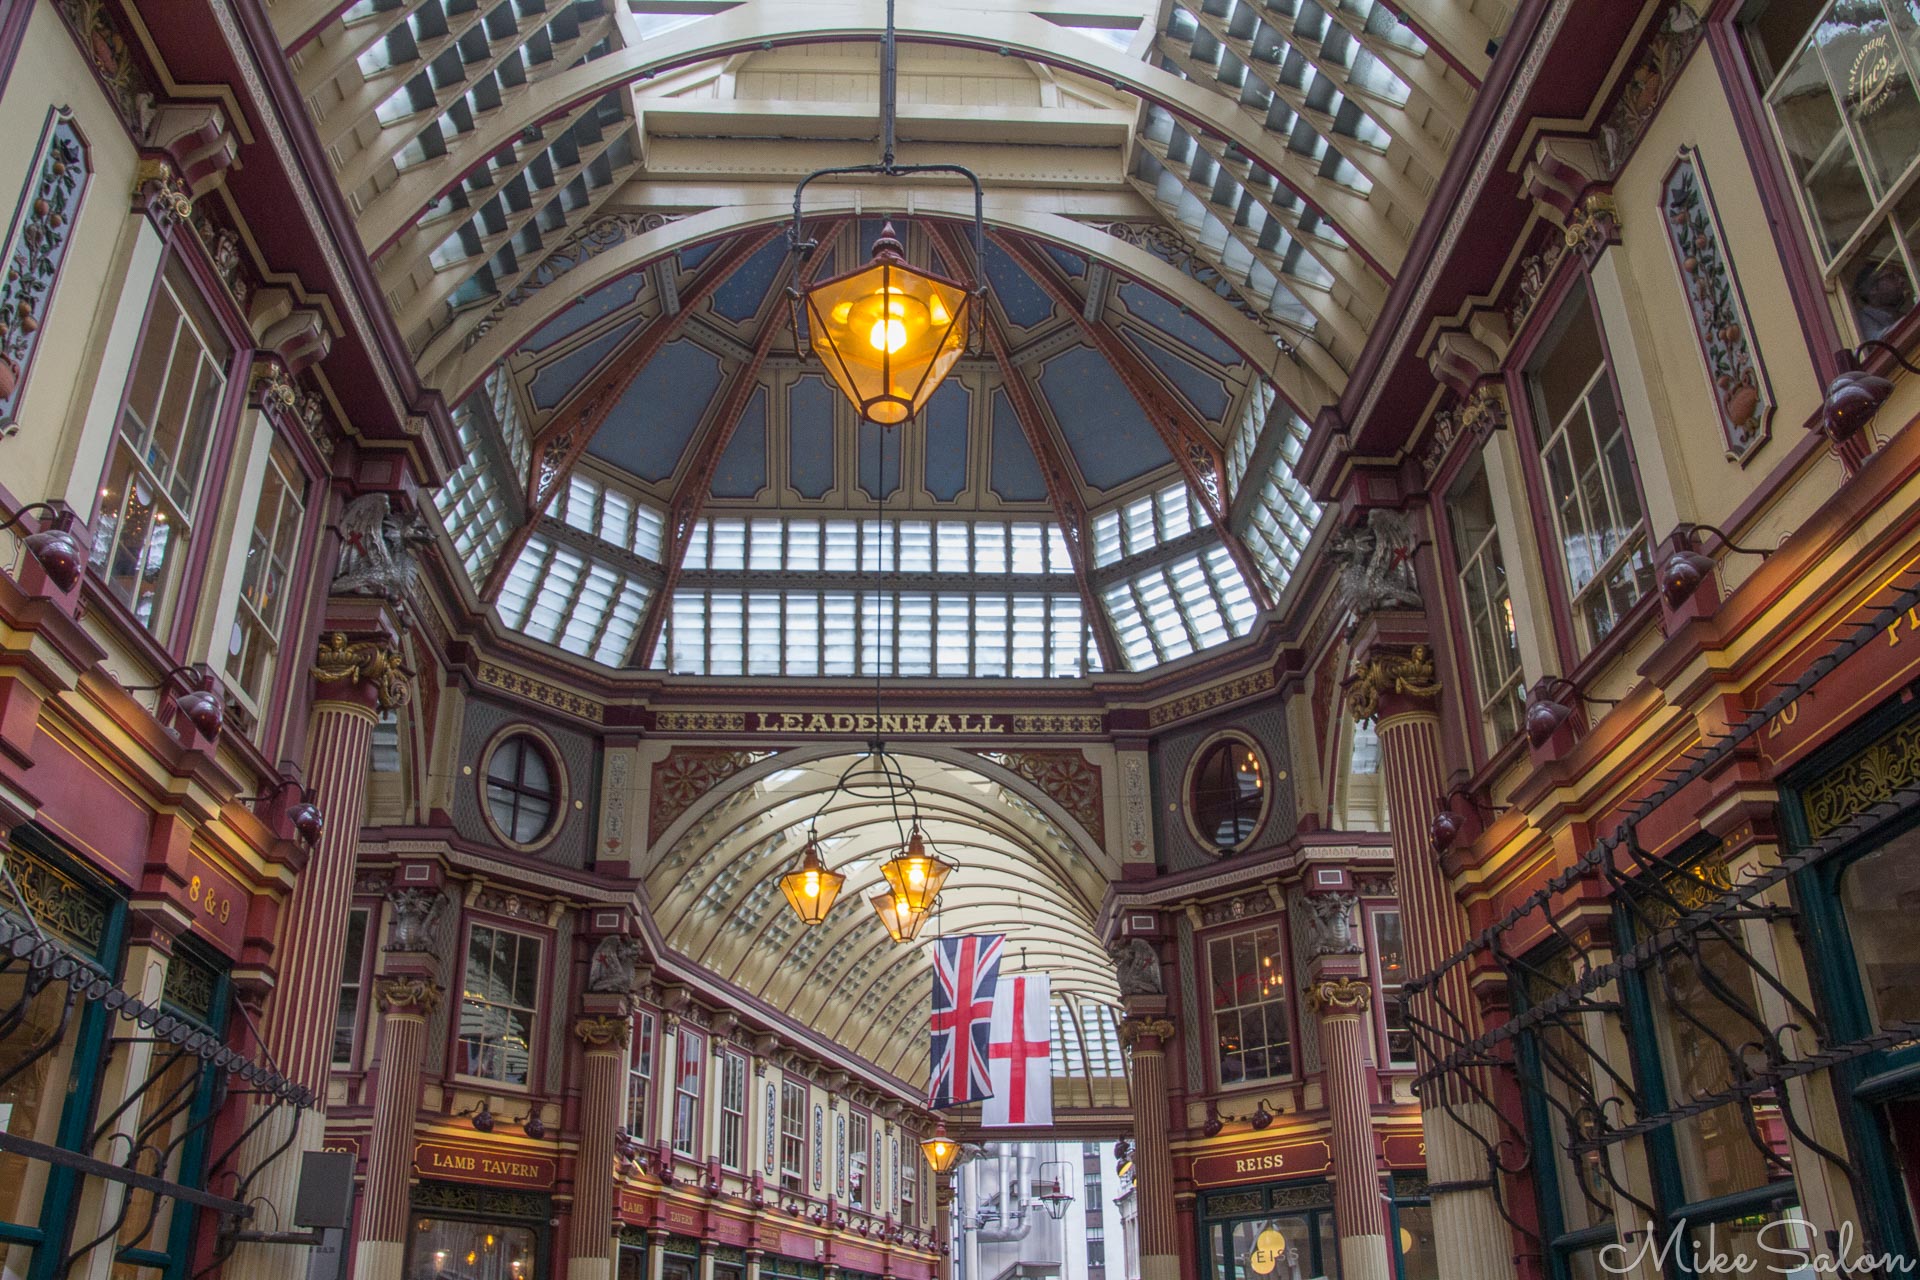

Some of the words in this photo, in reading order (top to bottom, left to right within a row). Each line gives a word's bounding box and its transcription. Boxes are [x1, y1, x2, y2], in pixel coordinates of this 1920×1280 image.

[756, 713, 1004, 732] LEADENHALL
[190, 875, 200, 902] 8
[204, 888, 216, 916] &
[220, 899, 230, 924] 9
[433, 1153, 476, 1170] LAMB
[482, 1159, 540, 1178] TAVERN
[1236, 1154, 1284, 1173] REISS
[622, 1200, 645, 1215] LAMB
[670, 1211, 694, 1225] TAVERN
